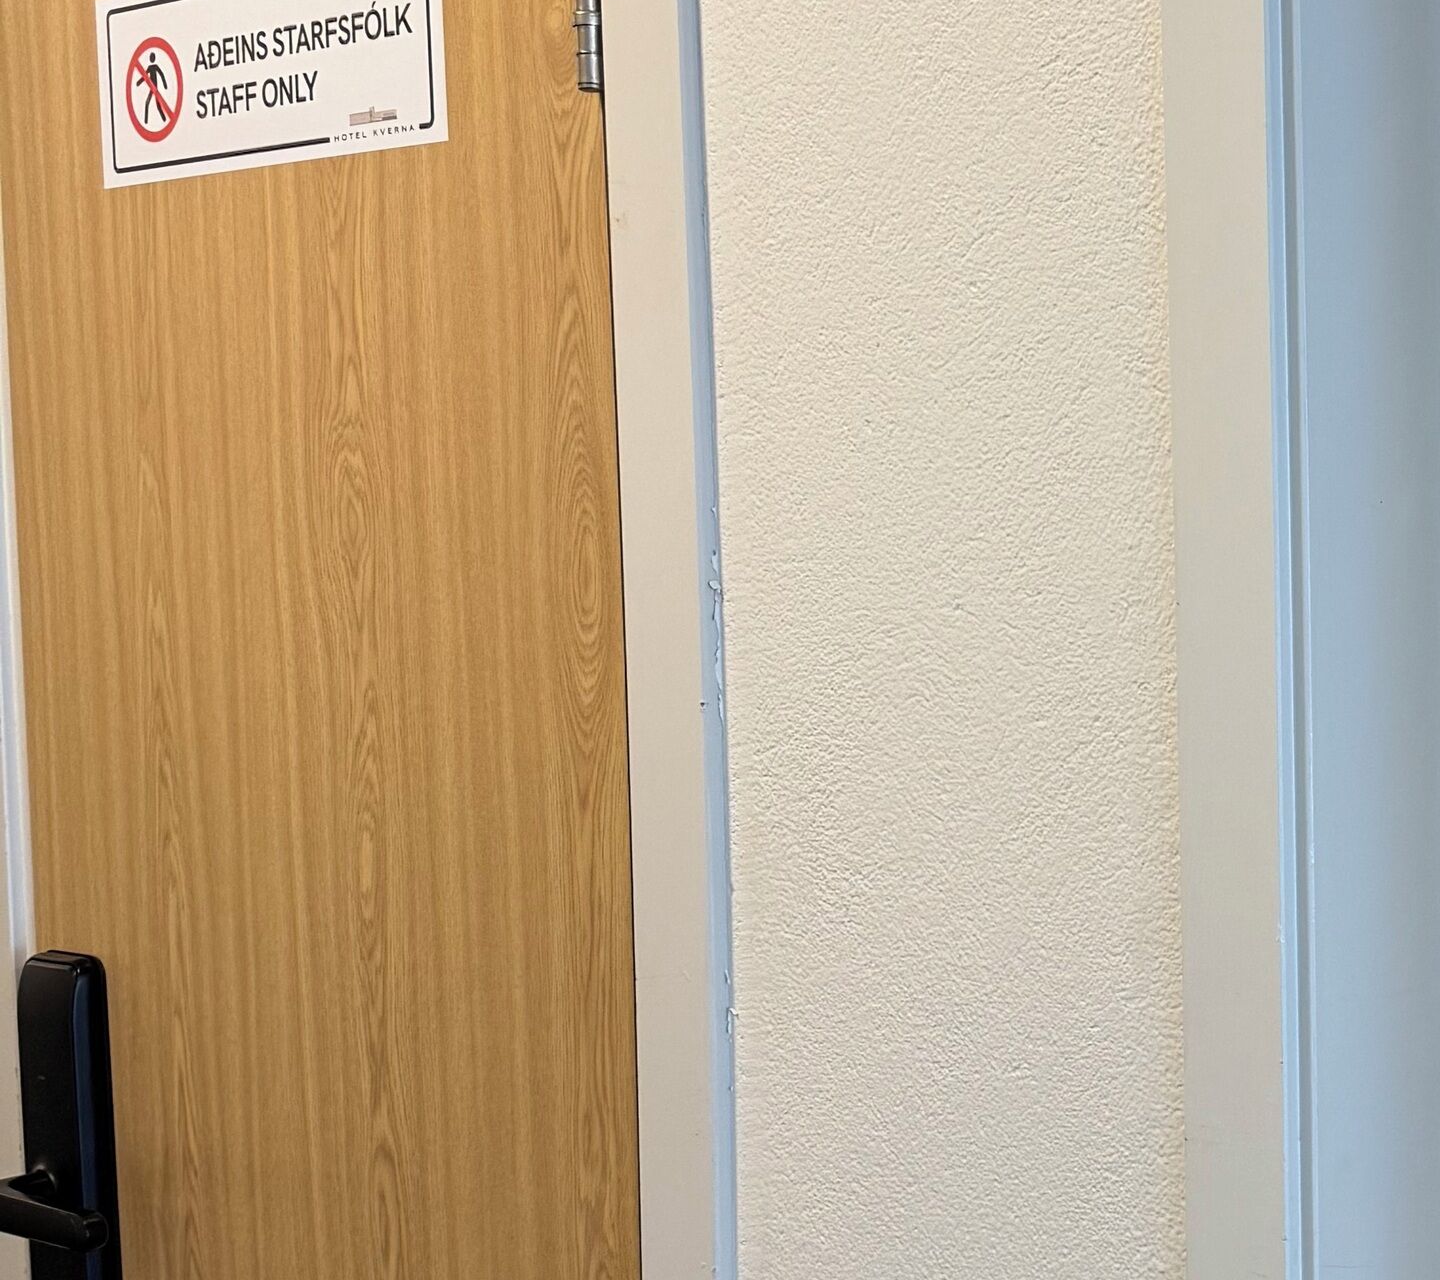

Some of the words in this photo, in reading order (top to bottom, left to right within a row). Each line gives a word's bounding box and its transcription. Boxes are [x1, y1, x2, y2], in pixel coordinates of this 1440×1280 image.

[194, 30, 269, 73] AÐEINS
[272, 0, 413, 57] STARFSFÓLK
[196, 81, 257, 120] STAFF
[262, 70, 318, 108] ONLY
[333, 131, 367, 143] HOTEL
[373, 124, 415, 137] KVERNA
